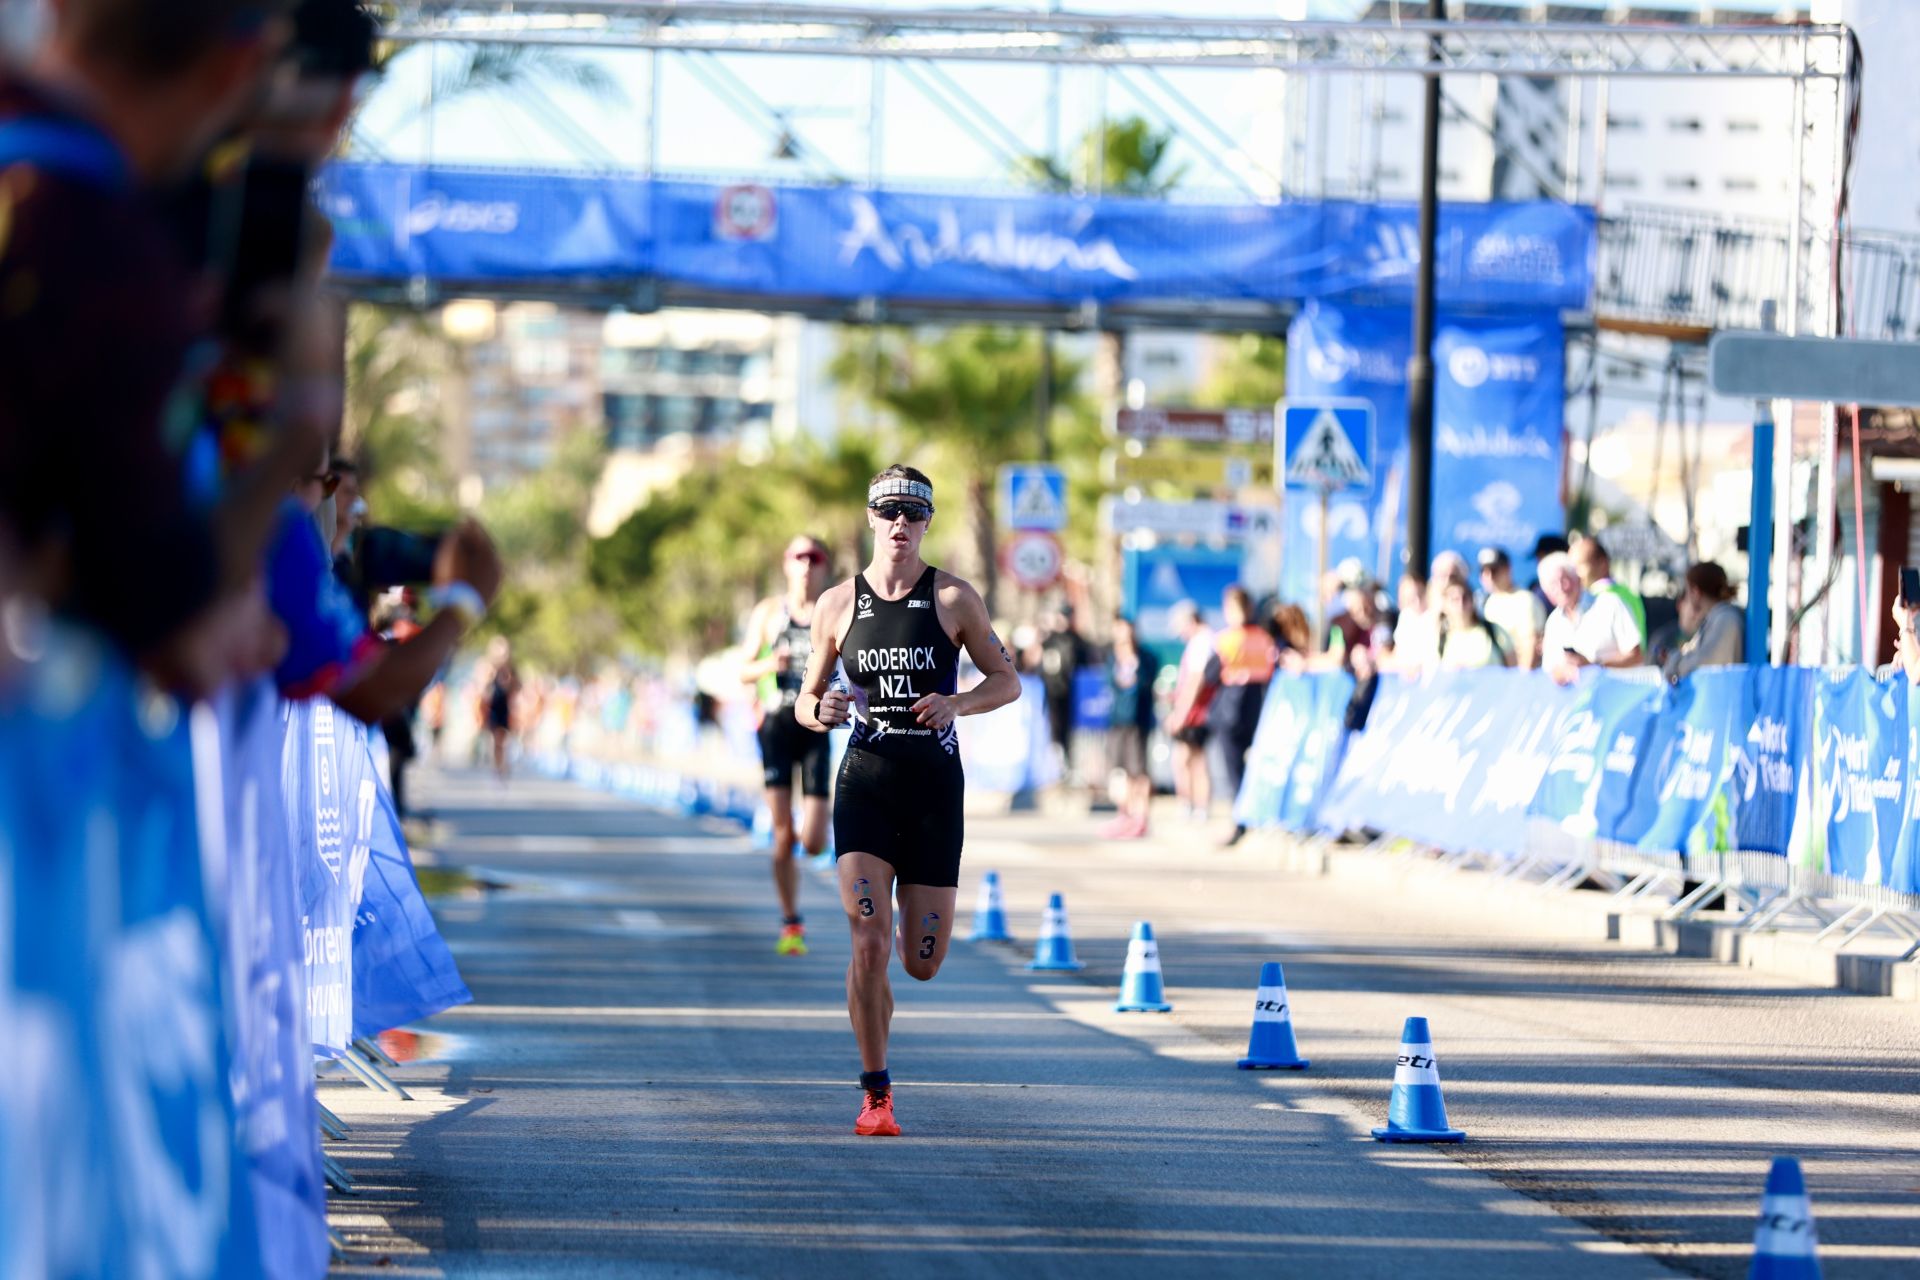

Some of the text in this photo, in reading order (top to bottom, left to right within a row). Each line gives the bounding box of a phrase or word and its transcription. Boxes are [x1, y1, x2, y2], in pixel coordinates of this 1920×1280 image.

[857, 646, 936, 673] RODERICK
[879, 674, 921, 699] NZL
[886, 727, 932, 736] Muscle Concepts
[858, 897, 874, 917] 3
[919, 935, 936, 960] 3
